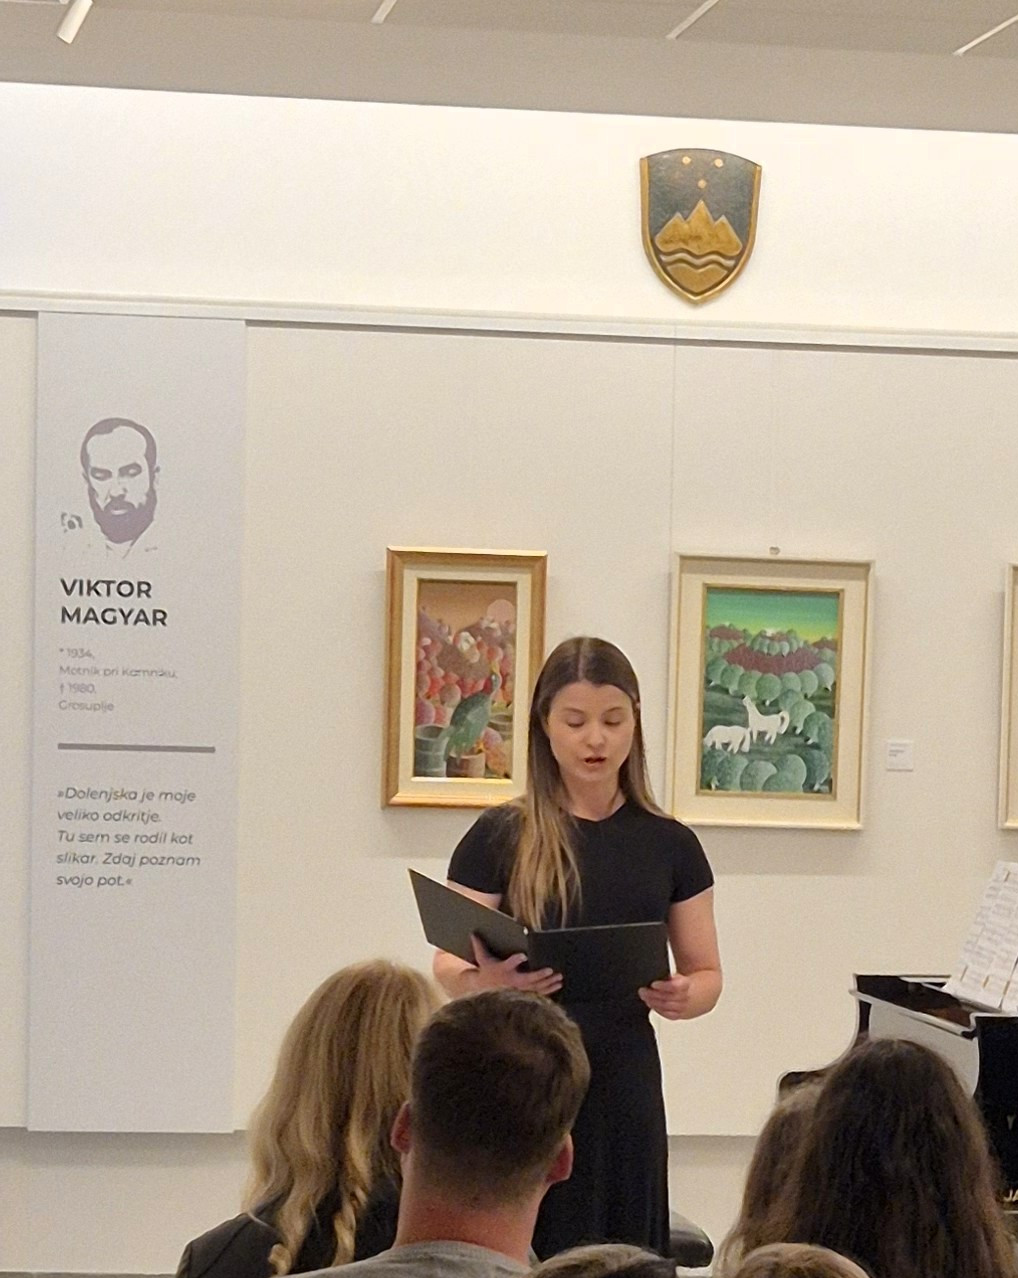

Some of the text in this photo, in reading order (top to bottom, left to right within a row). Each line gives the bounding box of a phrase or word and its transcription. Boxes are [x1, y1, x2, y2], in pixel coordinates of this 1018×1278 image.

[60, 578, 153, 598] VIKTOR
[60, 606, 168, 627] MAGYAR
[57, 787, 197, 804] »Dolenjska je moje
[57, 809, 100, 822] veliko
[57, 830, 194, 845] Tu sem se rodil kot
[102, 852, 137, 867] Zdaj
[139, 855, 201, 867] poznam
[56, 874, 94, 888] svojo
